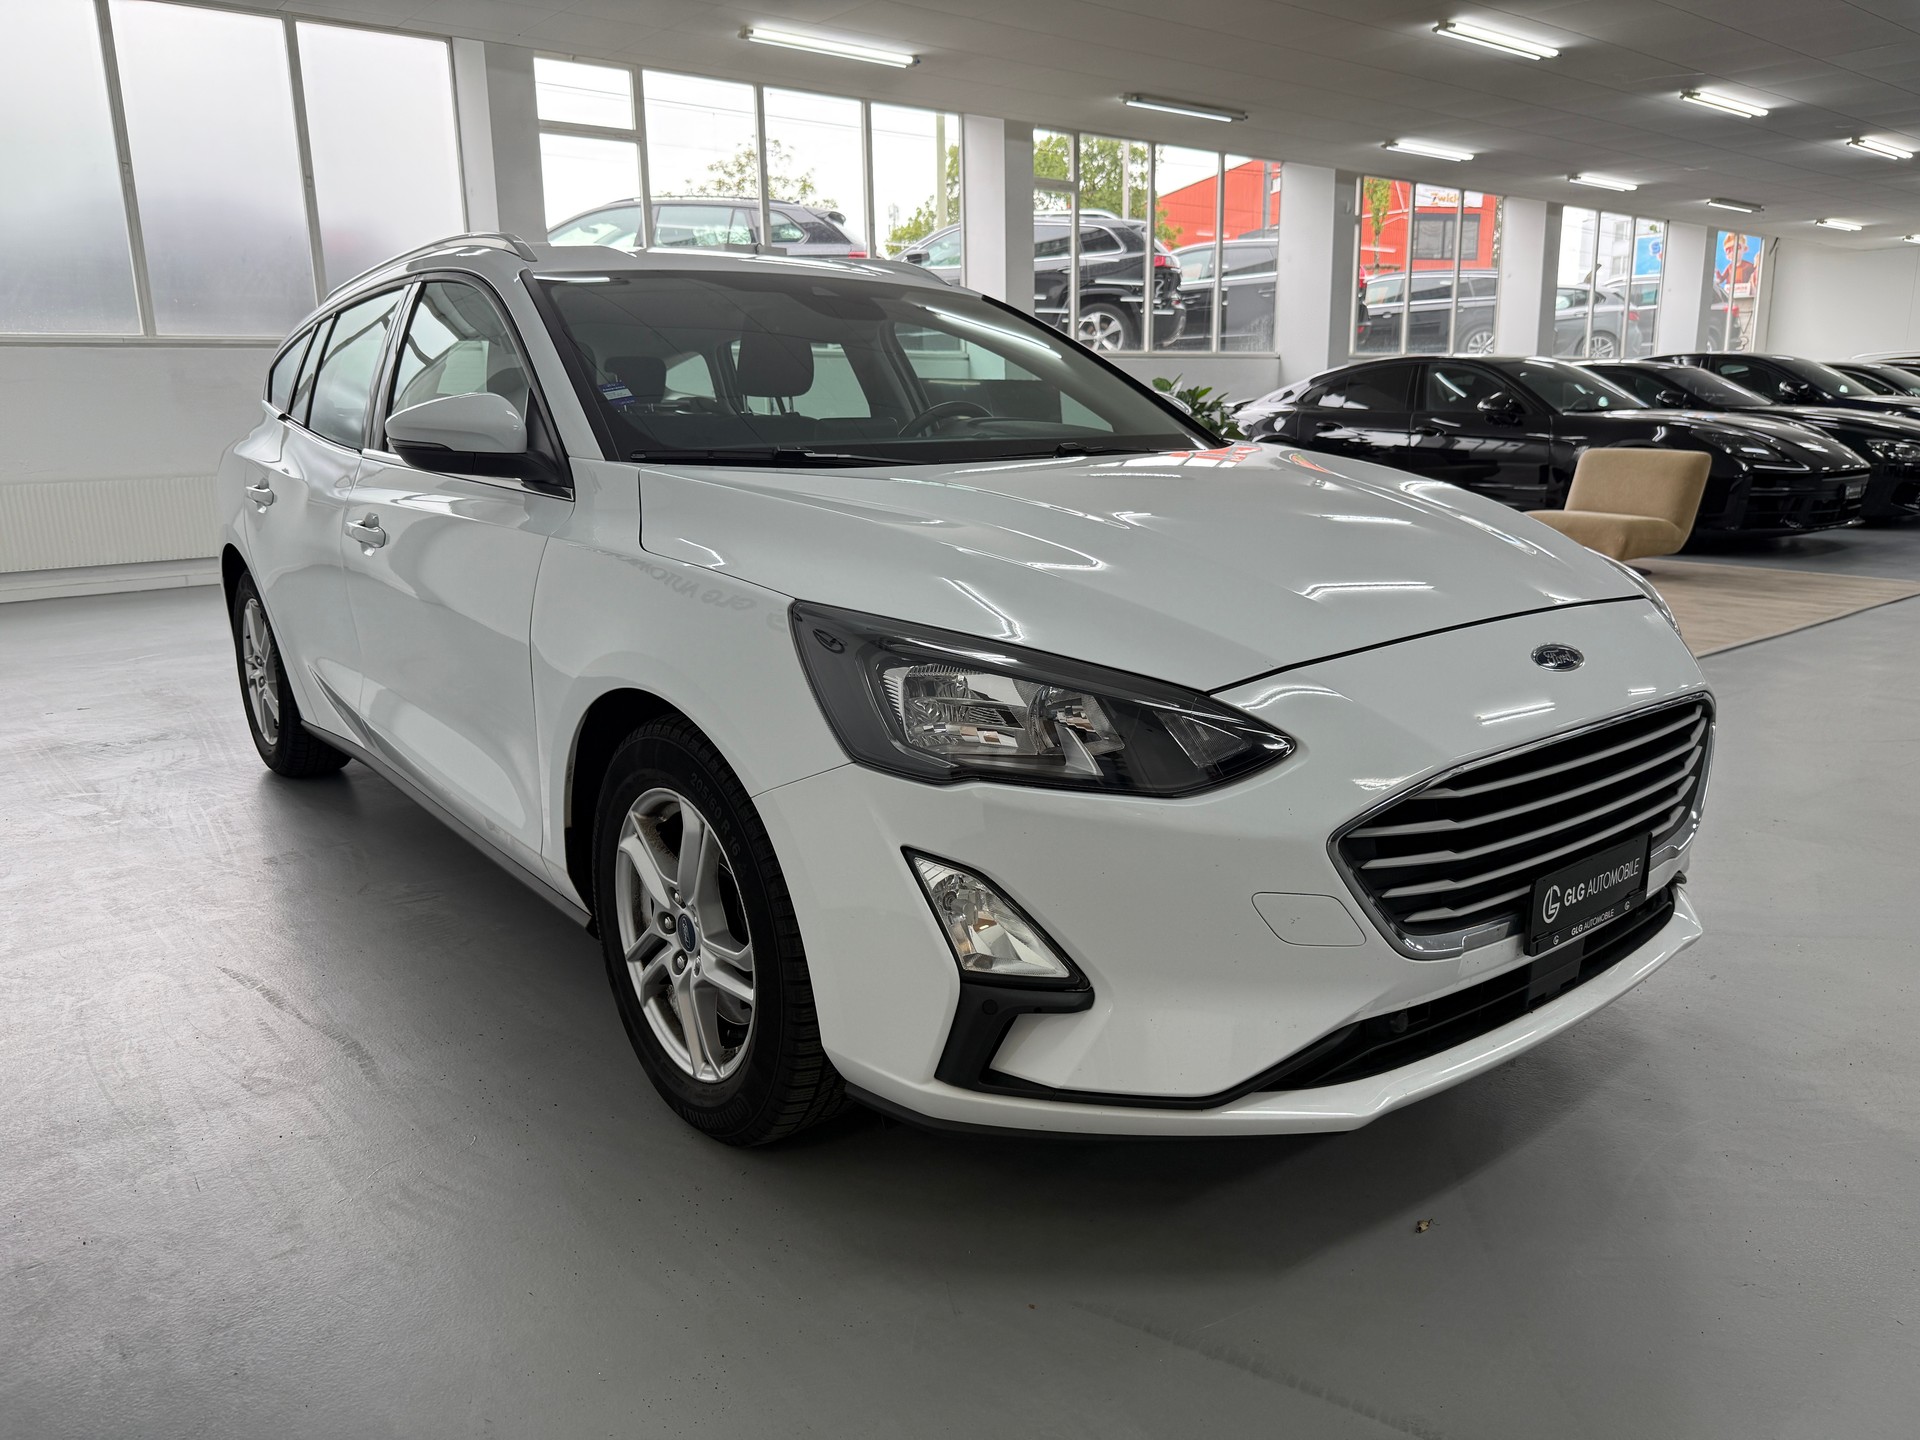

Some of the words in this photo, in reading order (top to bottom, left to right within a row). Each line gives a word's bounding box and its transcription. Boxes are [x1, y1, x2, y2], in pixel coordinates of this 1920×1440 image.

[1542, 649, 1576, 668] Ford
[1564, 883, 1585, 907] GLG
[1586, 858, 1640, 897] AUTOMOBILE
[1571, 924, 1583, 935] GLG
[1583, 909, 1614, 930] AUTOMOBILE
